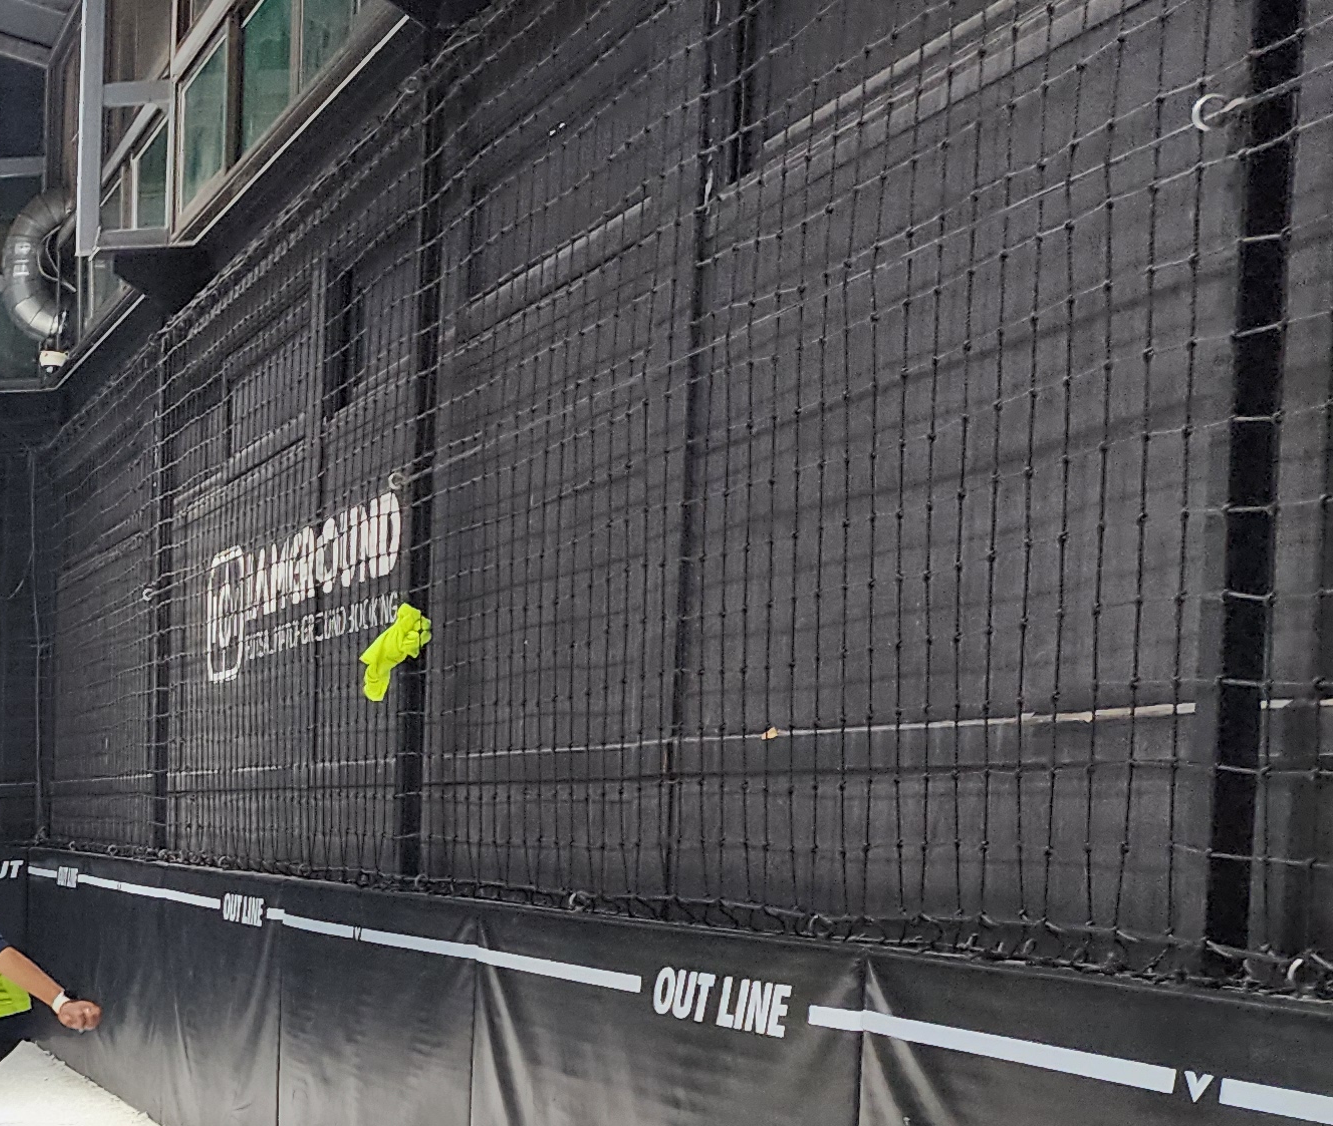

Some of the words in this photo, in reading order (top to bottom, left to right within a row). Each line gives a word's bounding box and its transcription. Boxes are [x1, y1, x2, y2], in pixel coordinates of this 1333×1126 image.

[223, 892, 243, 922] OUT
[241, 896, 264, 927] LINE
[653, 966, 716, 1023] OUT
[716, 976, 792, 1039] LINE
